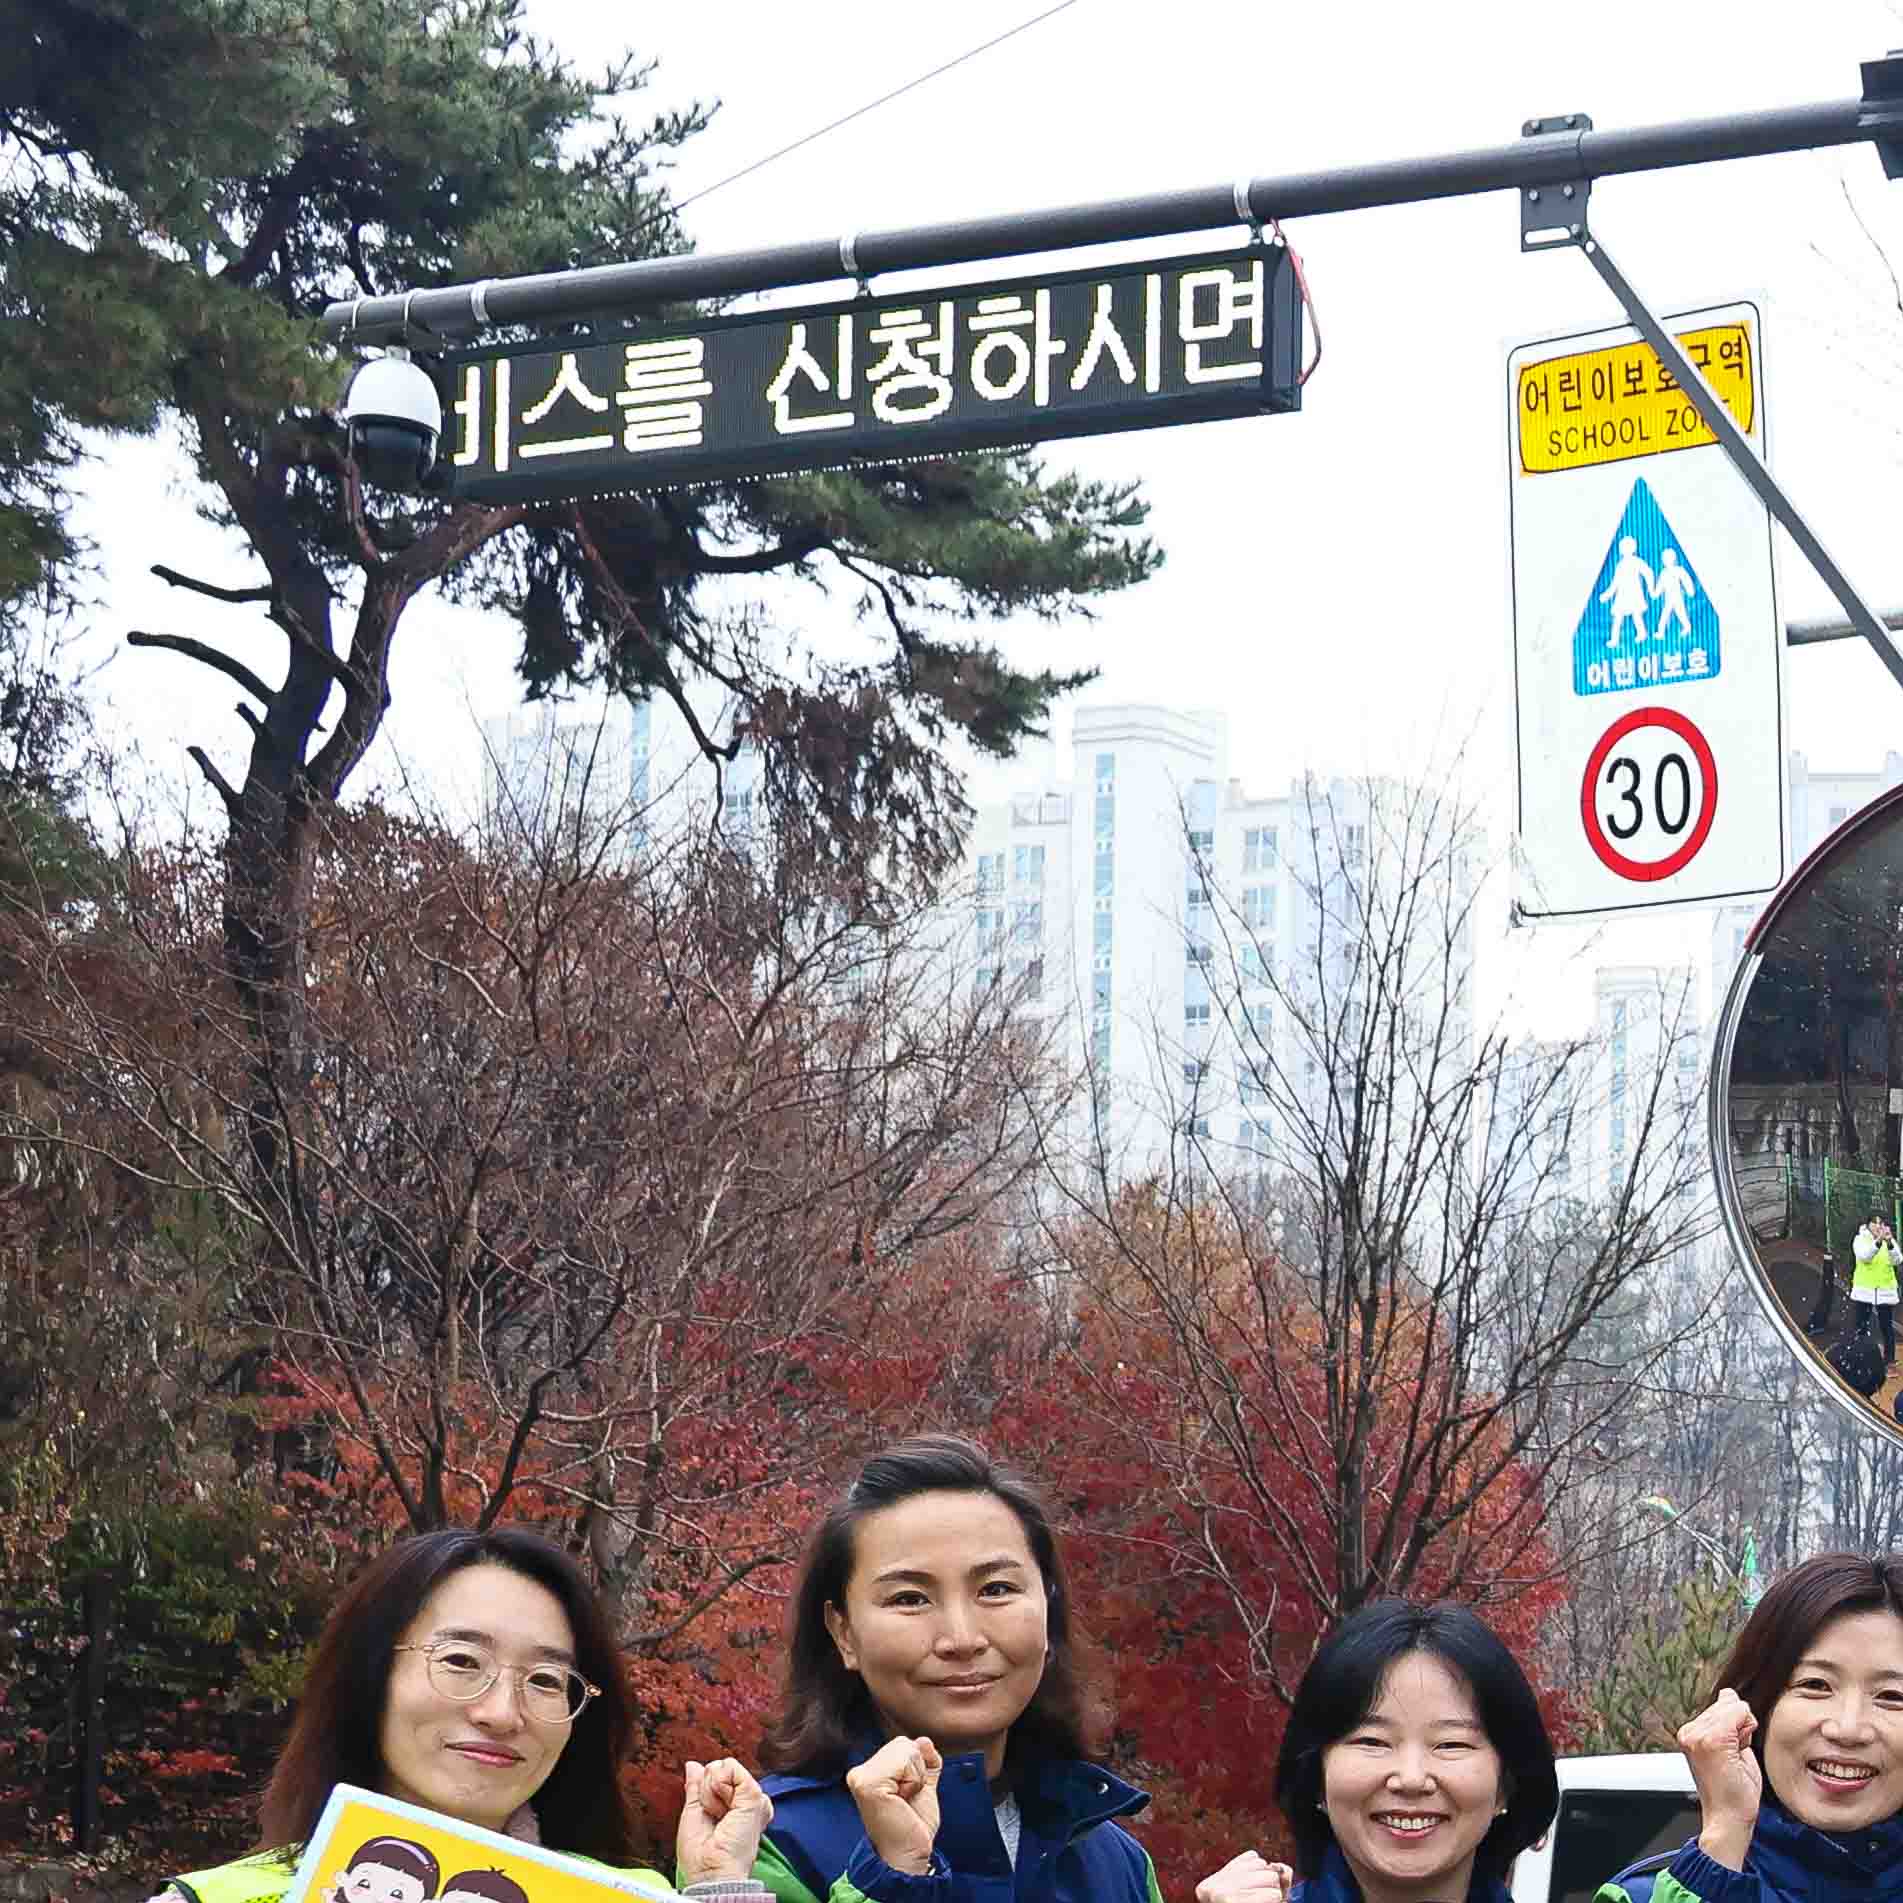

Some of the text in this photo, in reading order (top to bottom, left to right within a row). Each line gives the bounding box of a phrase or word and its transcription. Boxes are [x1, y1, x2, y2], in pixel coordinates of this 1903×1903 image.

[766, 260, 1264, 438] 신청하시면
[1549, 400, 1729, 457] SCHOOL ZO
[1587, 647, 1709, 689] 어린이보호
[1605, 753, 1691, 840] 30
